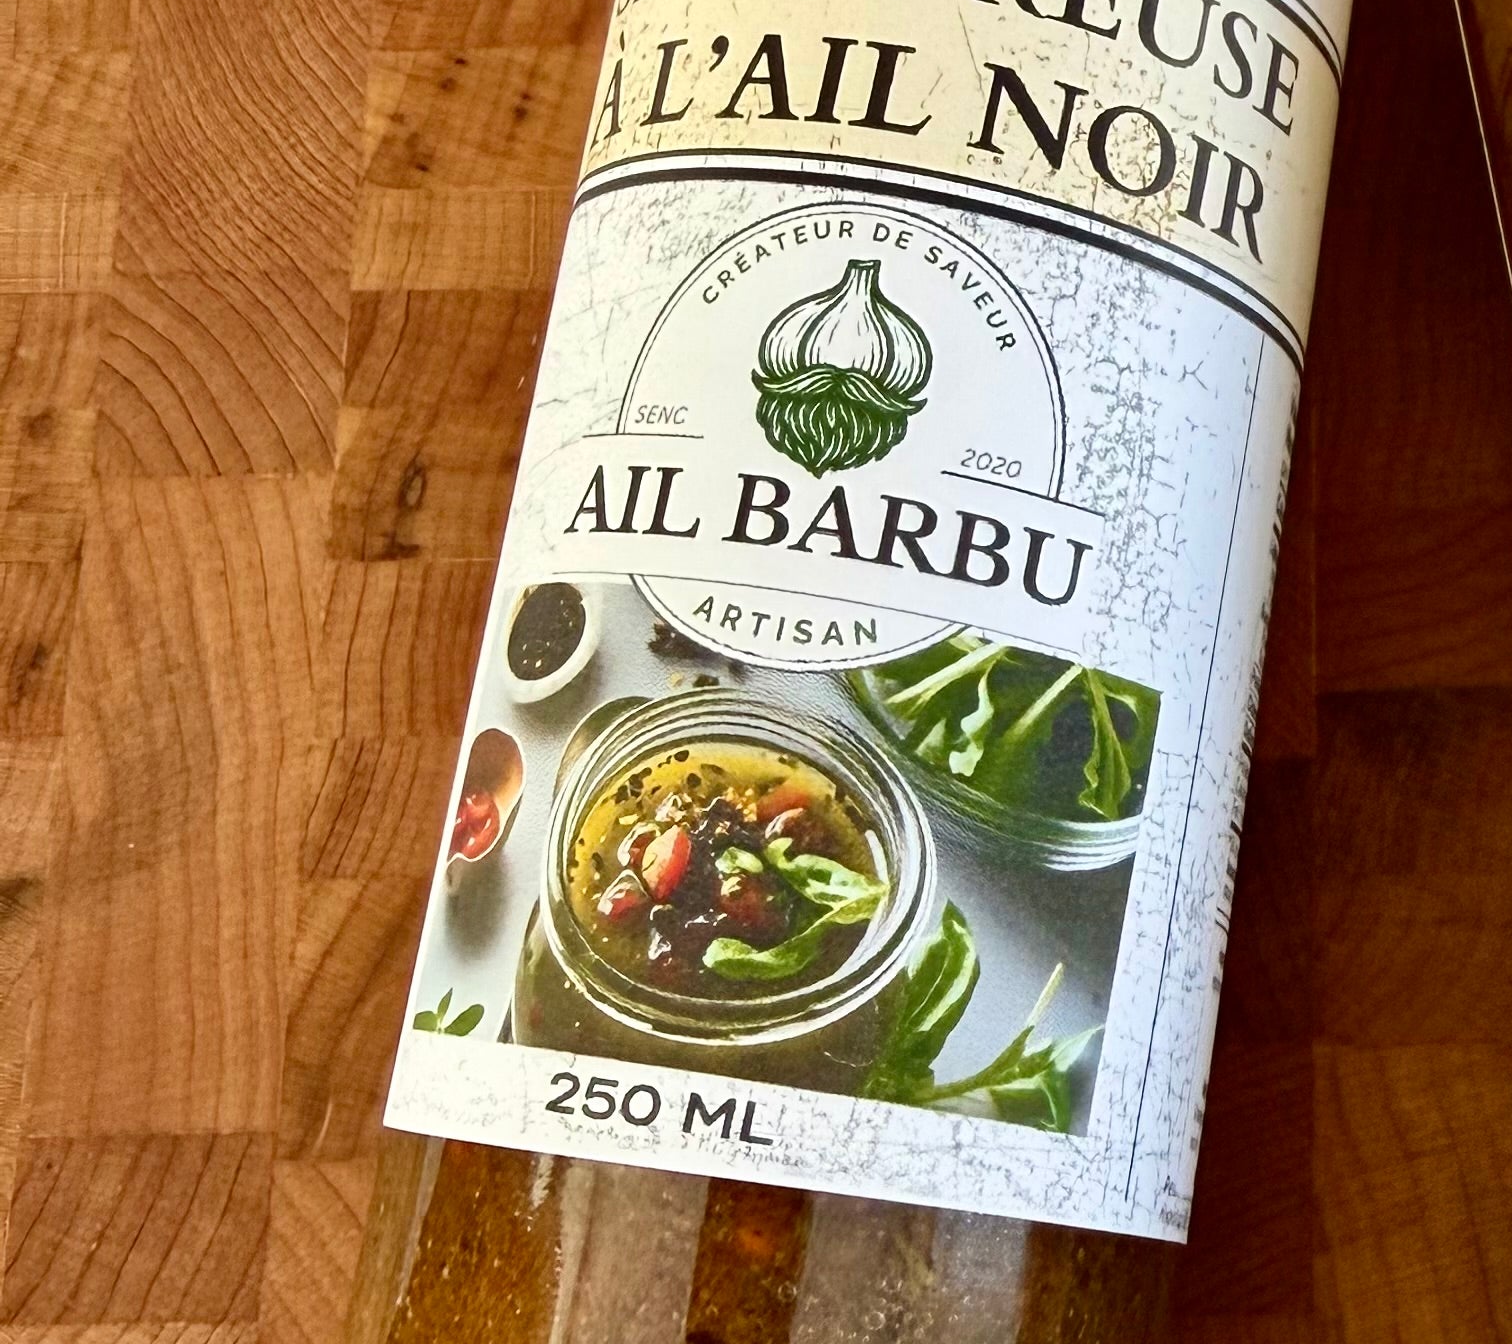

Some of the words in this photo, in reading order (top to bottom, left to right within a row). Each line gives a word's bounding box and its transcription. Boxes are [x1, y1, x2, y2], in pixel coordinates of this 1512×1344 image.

[592, 30, 628, 148] À
[968, 62, 1264, 265] NOIR
[701, 219, 855, 306] CRÉATEUR
[873, 221, 914, 251] DE
[924, 246, 1017, 353] SAVEUR
[634, 404, 690, 426] SENC
[960, 448, 1023, 479] 2020
[564, 465, 701, 537] AIL
[722, 473, 1093, 606] BARBU
[693, 595, 878, 646] ARTISAN
[545, 1072, 662, 1126] 250
[683, 1092, 773, 1146] ML
